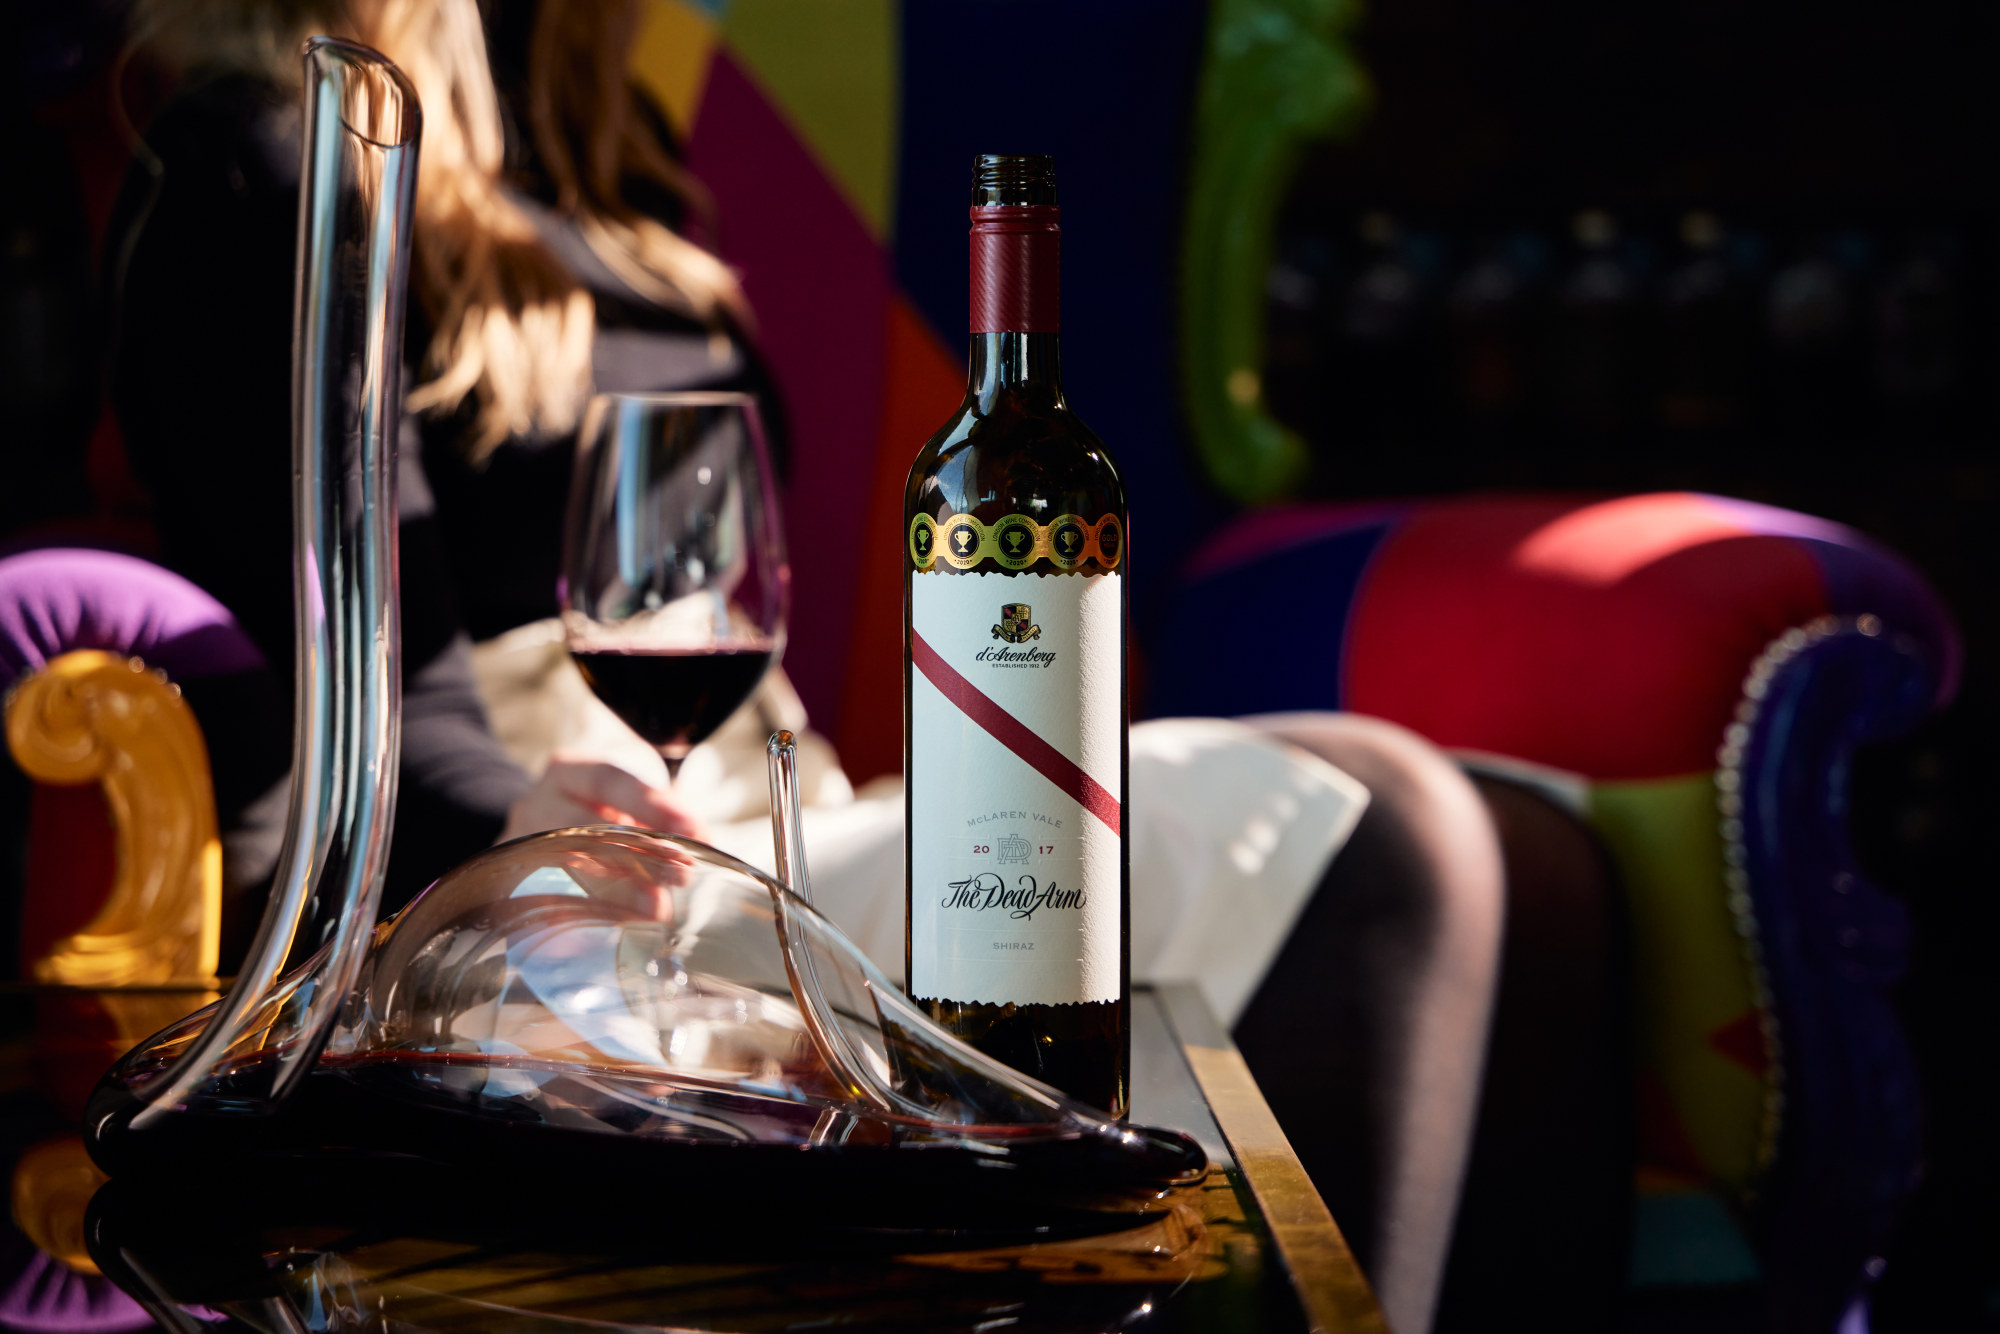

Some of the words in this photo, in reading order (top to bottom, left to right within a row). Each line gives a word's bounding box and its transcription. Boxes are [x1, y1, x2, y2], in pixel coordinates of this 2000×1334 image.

[992, 523, 1005, 542] LONDON
[975, 646, 1056, 669] d'Arenberg
[1033, 813, 1063, 829] VALE
[973, 845, 990, 854] 20
[1039, 845, 1054, 855] 17
[941, 874, 981, 910] The
[977, 872, 1037, 912] Dead
[1010, 881, 1087, 922] Arm
[993, 942, 1035, 951] SHIRAZ
